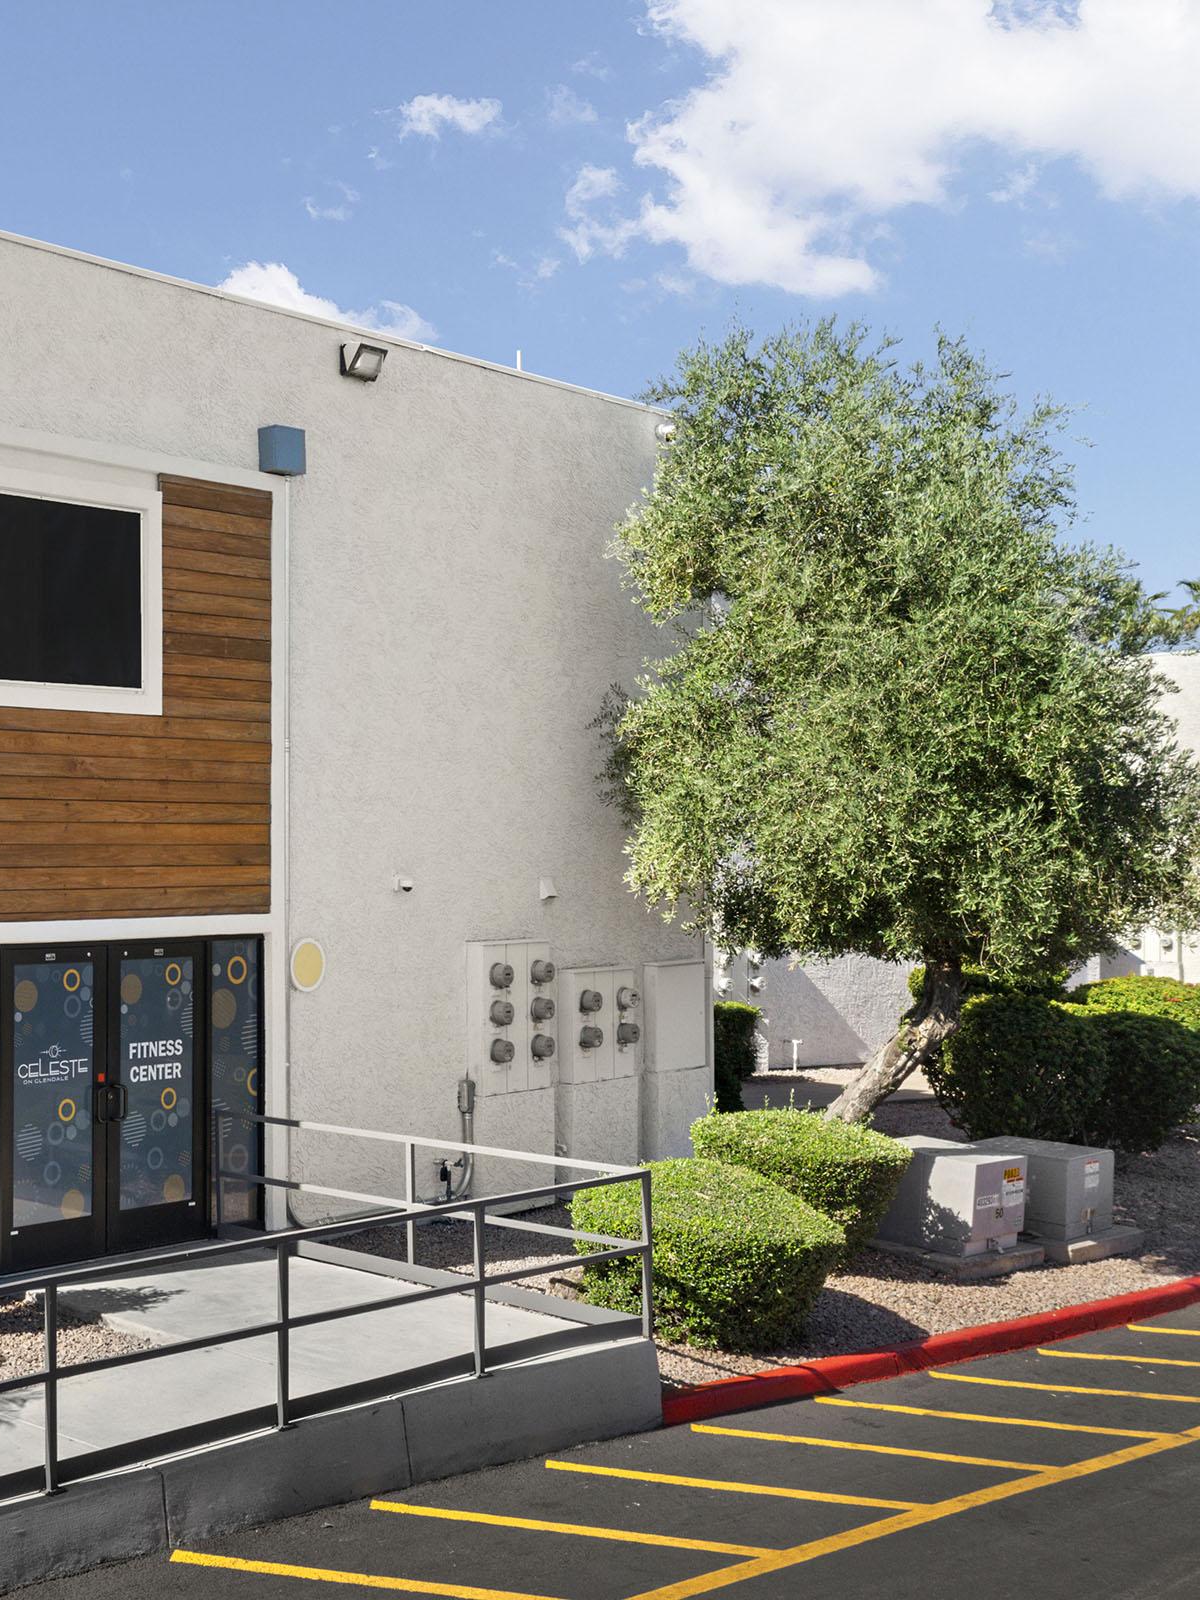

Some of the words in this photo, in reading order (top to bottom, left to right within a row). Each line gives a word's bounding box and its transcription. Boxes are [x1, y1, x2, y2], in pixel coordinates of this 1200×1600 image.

[129, 1039, 183, 1059] FITNESS
[17, 1058, 89, 1078] CELESTE
[130, 1062, 182, 1083] CENTER
